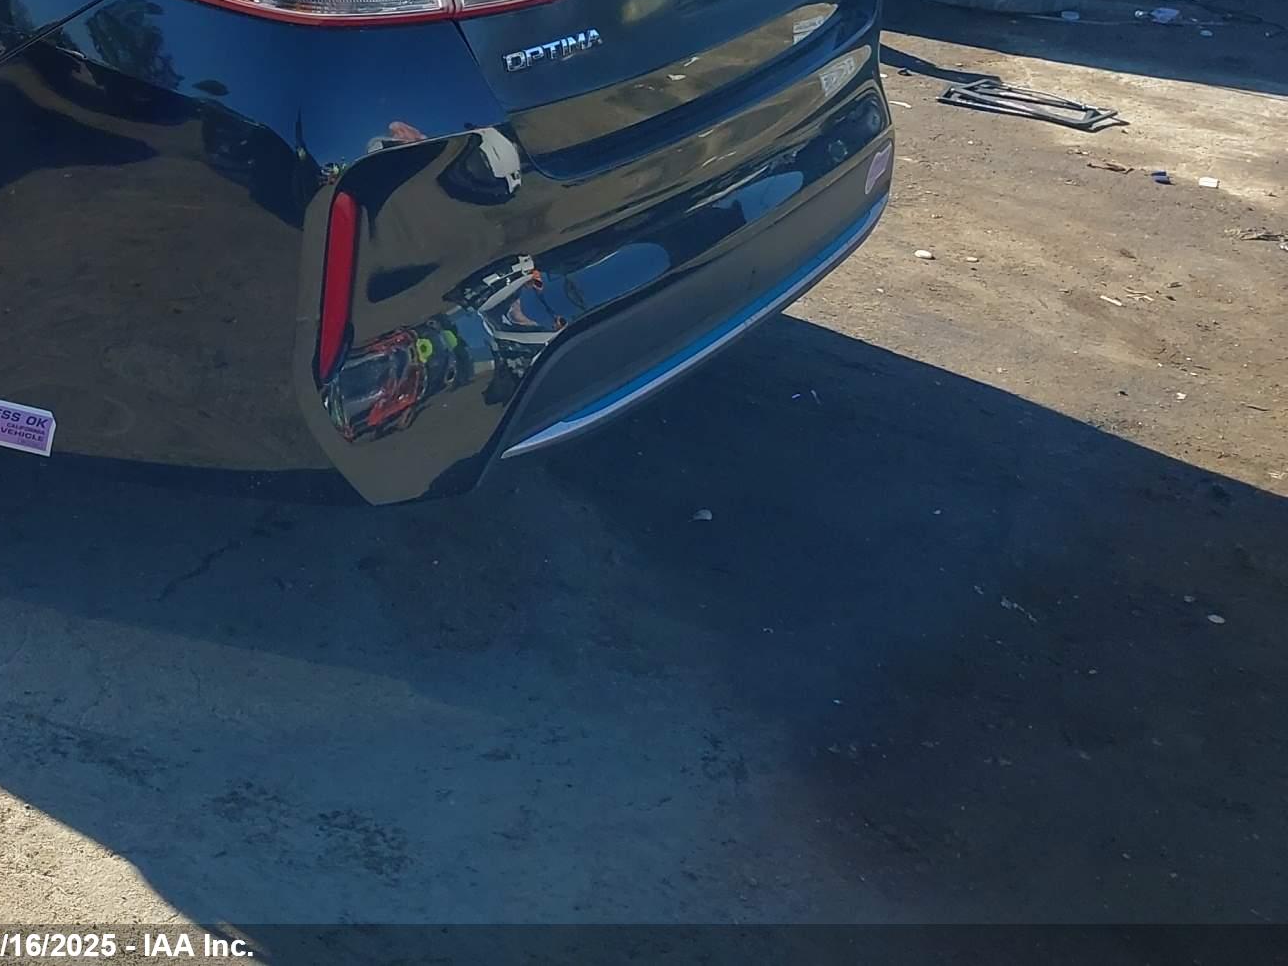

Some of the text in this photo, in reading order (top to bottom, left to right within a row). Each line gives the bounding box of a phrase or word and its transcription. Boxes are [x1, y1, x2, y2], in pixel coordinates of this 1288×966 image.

[504, 28, 603, 72] OPTIMA
[6, 422, 45, 435] CALIFORNIA
[25, 415, 49, 429] OK
[0, 427, 45, 442] VEHICLE
